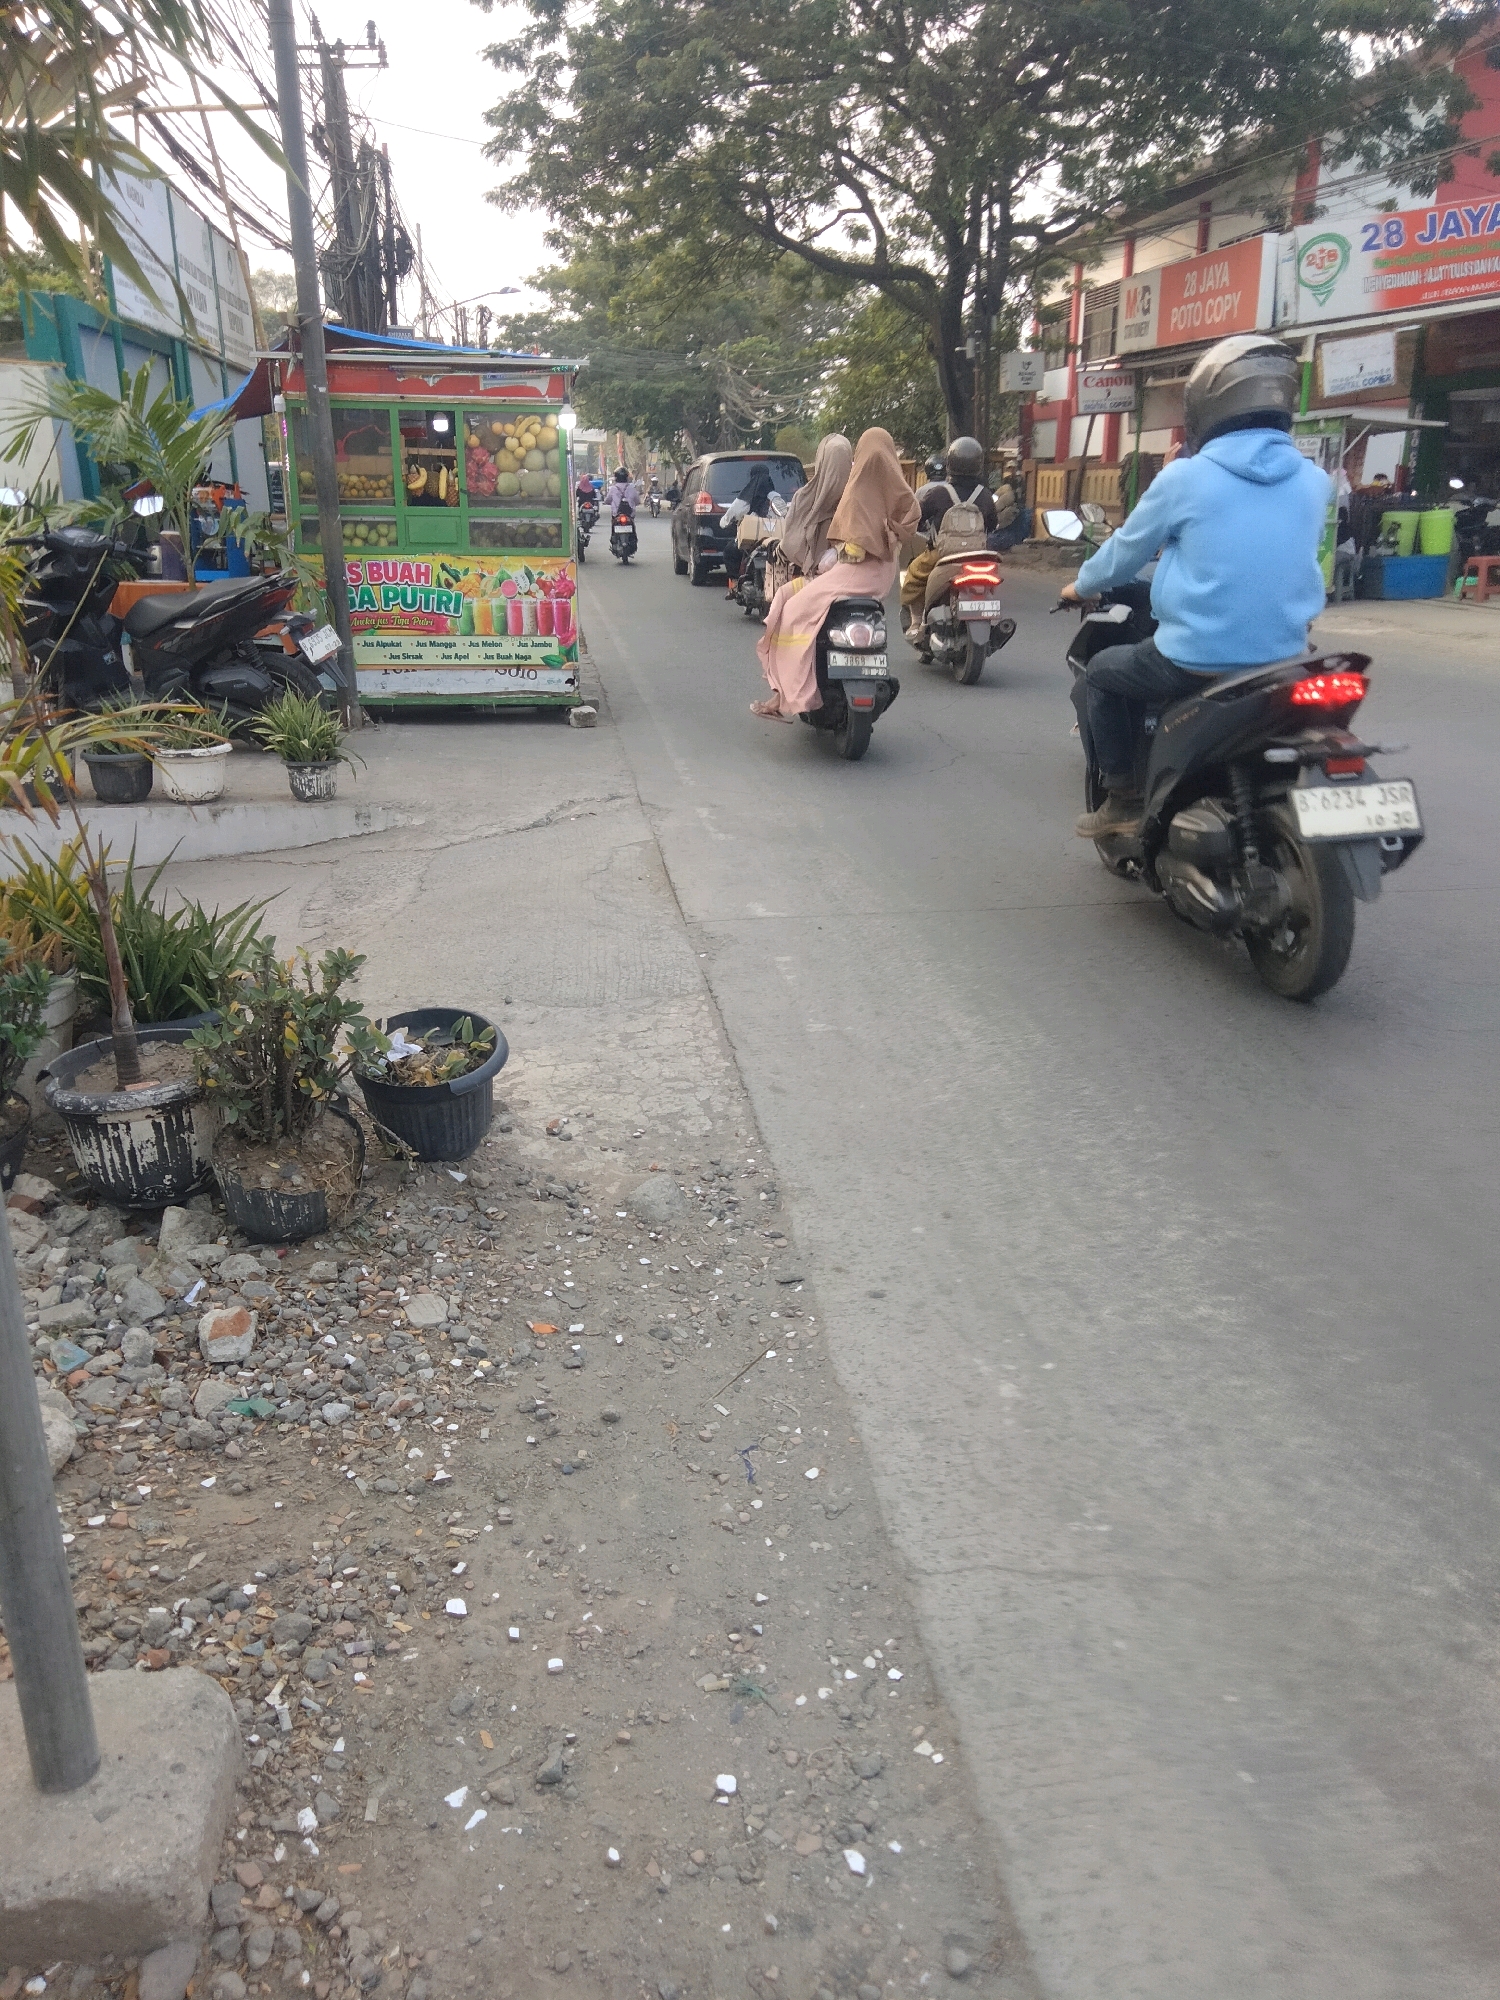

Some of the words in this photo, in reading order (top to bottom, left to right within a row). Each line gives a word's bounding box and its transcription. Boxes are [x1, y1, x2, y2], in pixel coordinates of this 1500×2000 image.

[1360, 218, 1407, 252] 28
[1183, 270, 1197, 298] 28
[1200, 261, 1230, 292] JAYA
[1170, 300, 1203, 332] POTO
[1204, 291, 1242, 325] COPY
[1083, 375, 1132, 388] Canon
[365, 561, 432, 587] BUAH
[381, 585, 463, 617] PUTRI
[350, 616, 375, 627] Aneka
[374, 617, 389, 629] jus
[391, 615, 410, 627] Tiga
[375, 640, 403, 648] Alpukat
[429, 640, 457, 649] Mangga
[481, 640, 503, 648] Melon
[401, 652, 424, 660] Sirsak
[453, 653, 470, 661] Apel
[496, 652, 513, 660] Buah
[514, 653, 532, 661] Naga
